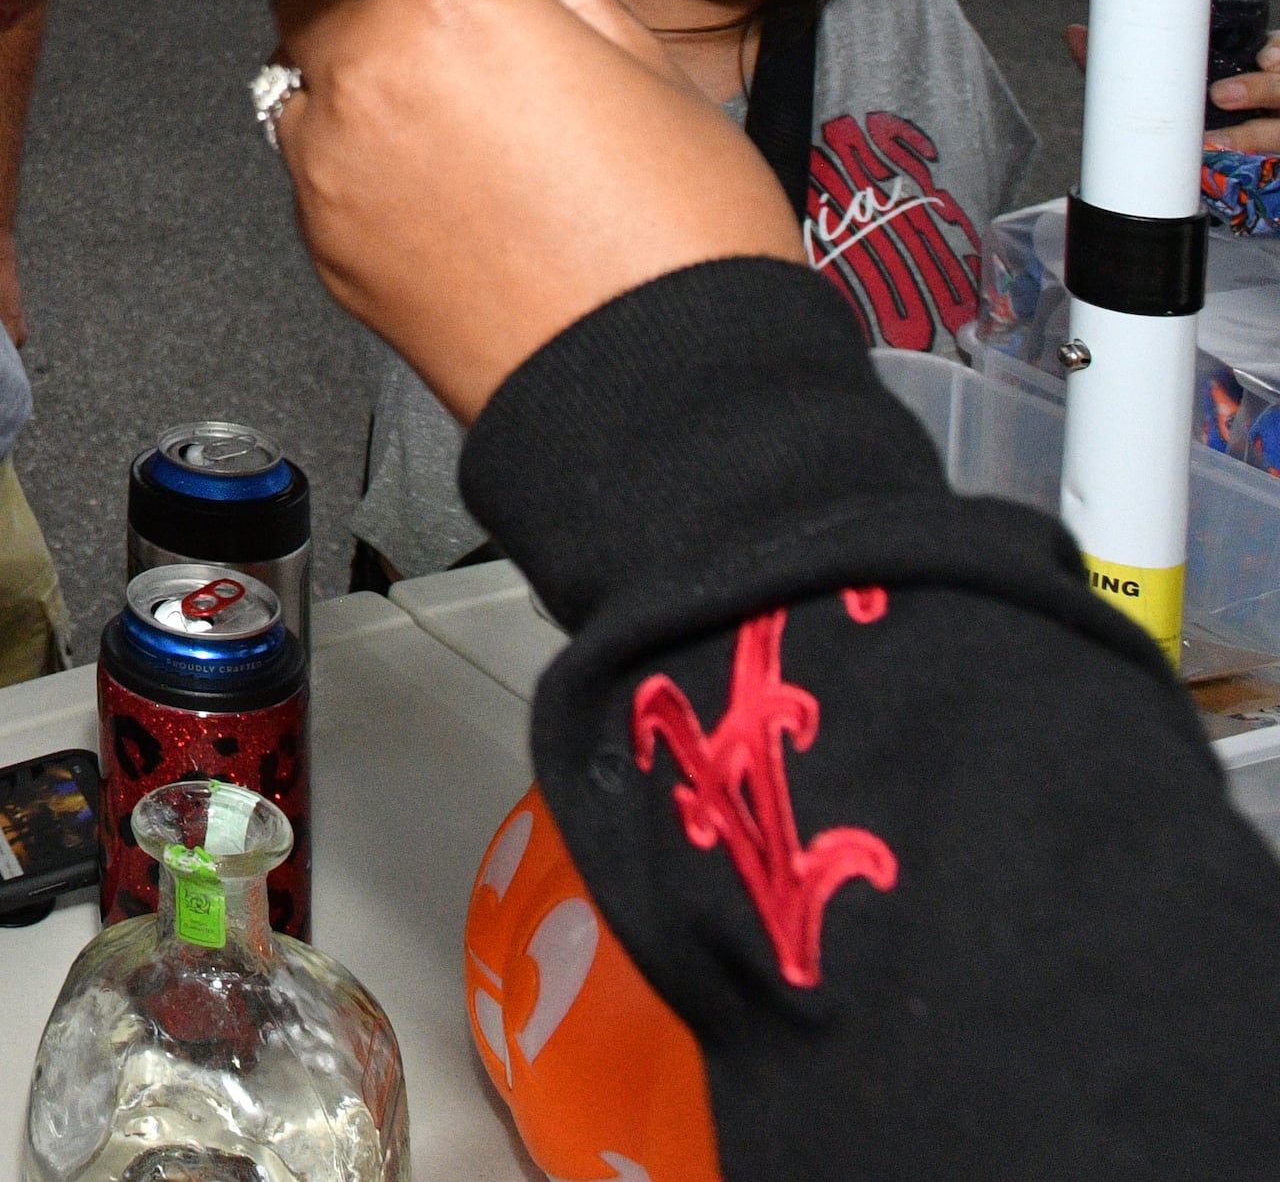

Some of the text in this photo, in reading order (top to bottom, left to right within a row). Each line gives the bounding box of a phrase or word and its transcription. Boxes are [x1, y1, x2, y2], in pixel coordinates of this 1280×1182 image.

[1091, 571, 1140, 597] ING
[166, 658, 263, 673] PROUDLY CRAFTED
